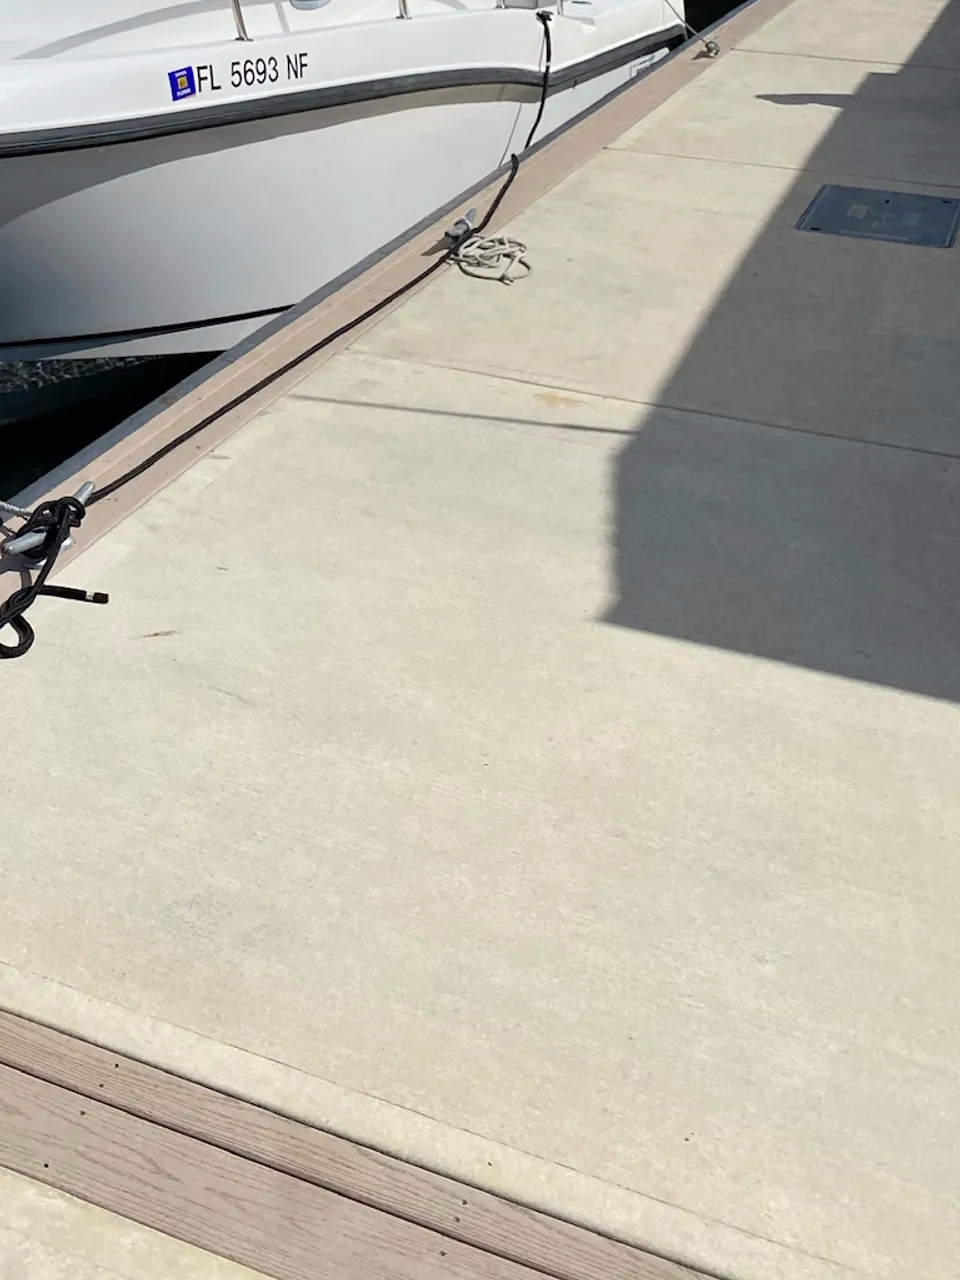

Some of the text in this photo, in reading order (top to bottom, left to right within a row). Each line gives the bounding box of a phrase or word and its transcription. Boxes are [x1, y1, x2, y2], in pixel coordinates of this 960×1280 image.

[196, 52, 308, 92] FL 5693 NF
